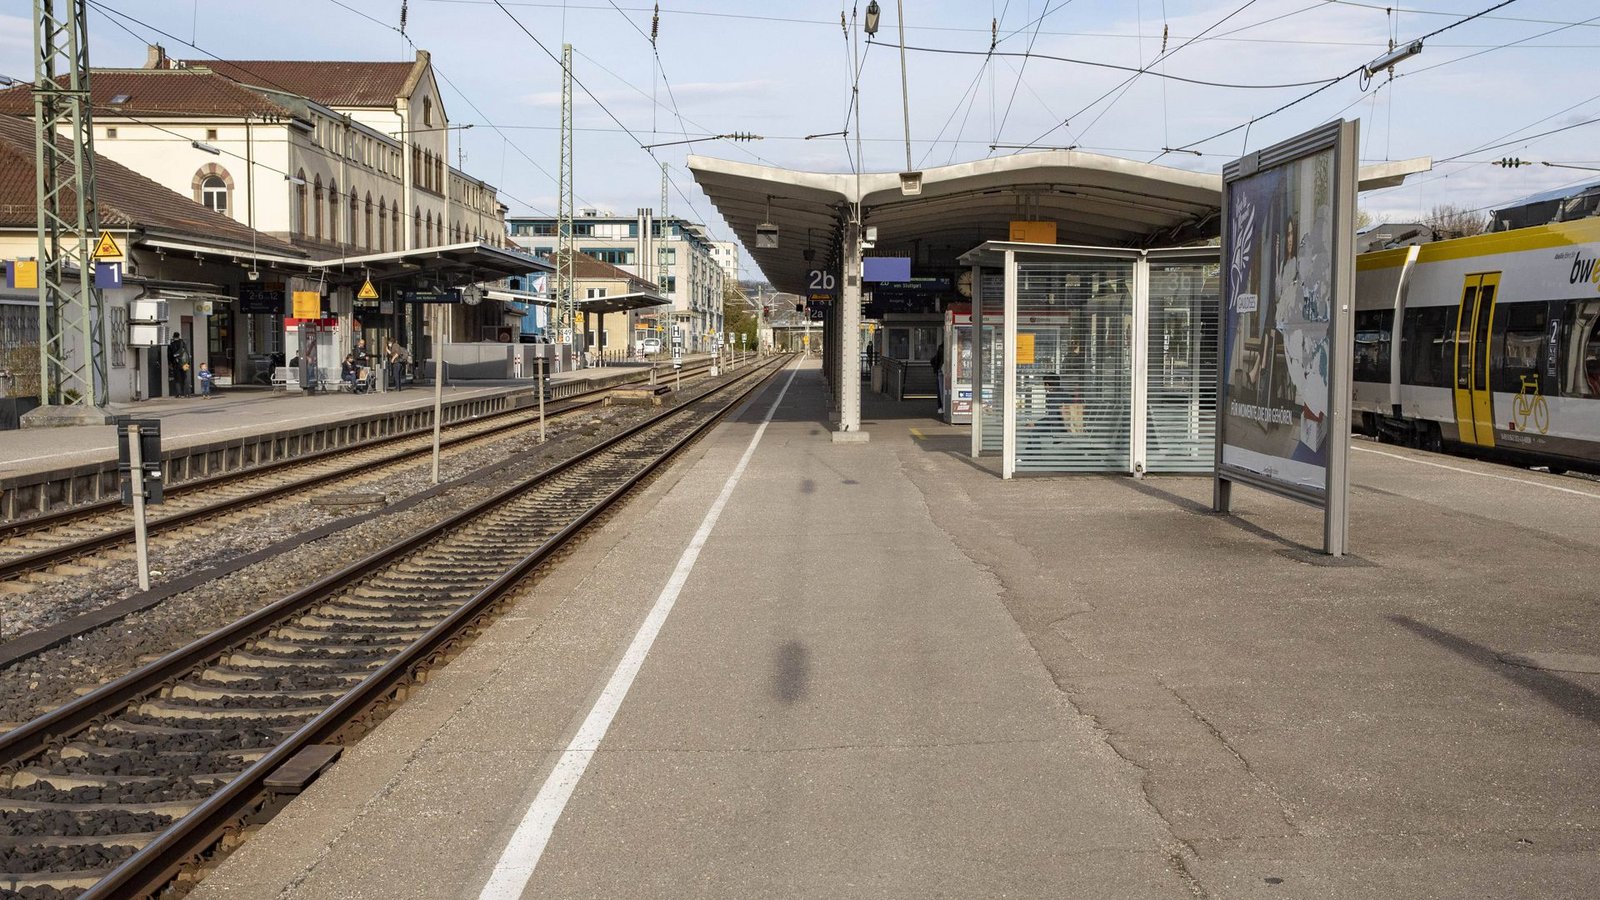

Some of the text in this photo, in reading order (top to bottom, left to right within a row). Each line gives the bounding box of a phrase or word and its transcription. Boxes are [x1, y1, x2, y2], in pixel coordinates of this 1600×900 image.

[109, 263, 119, 283] 1
[809, 270, 835, 290] 2b
[811, 309, 823, 318] 2a
[672, 325, 680, 337] H
[1550, 321, 1558, 344] 2
[673, 347, 681, 358] H
